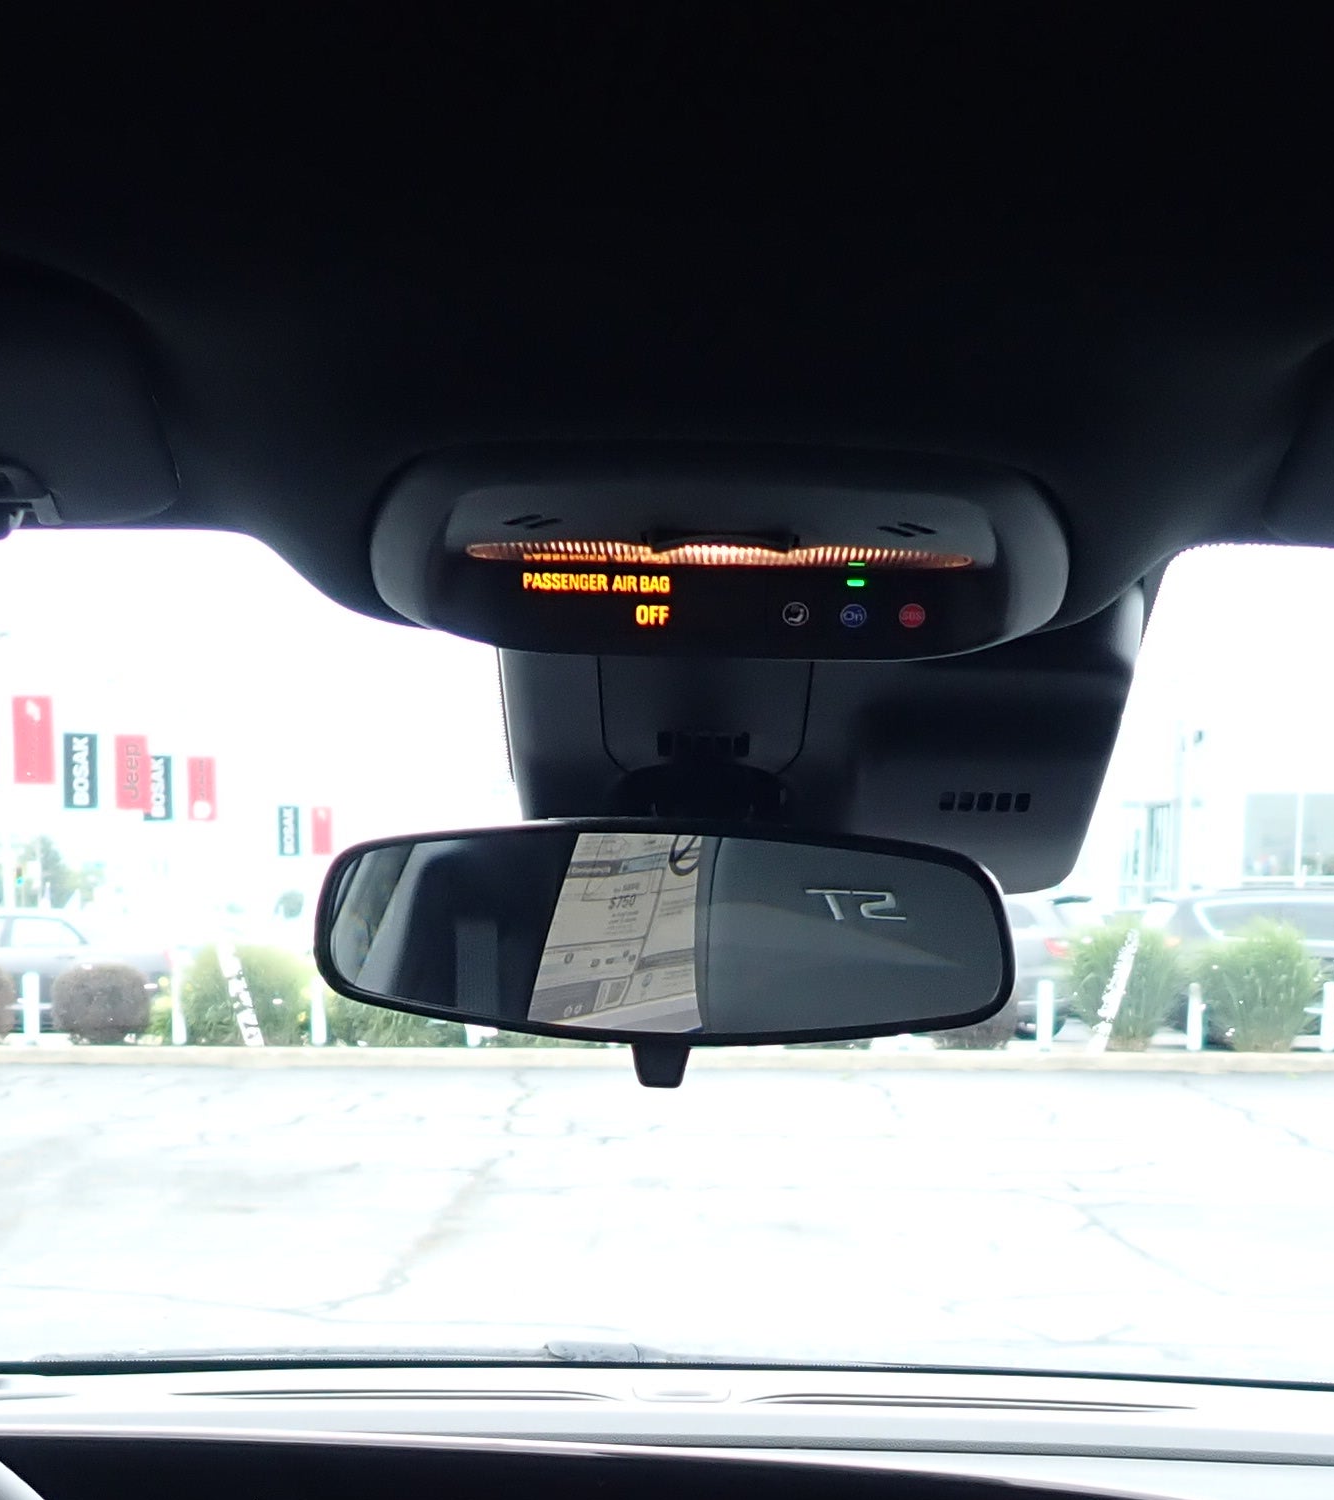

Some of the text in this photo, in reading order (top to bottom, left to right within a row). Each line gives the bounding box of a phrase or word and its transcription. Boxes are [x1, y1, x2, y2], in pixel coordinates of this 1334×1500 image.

[523, 572, 670, 593] PASSENGER AIR BAG
[635, 605, 669, 625] OFF
[73, 737, 92, 806] BOSAK
[123, 743, 142, 801] Jeep
[150, 757, 166, 819] BOSAK
[283, 807, 295, 854] BOSAK
